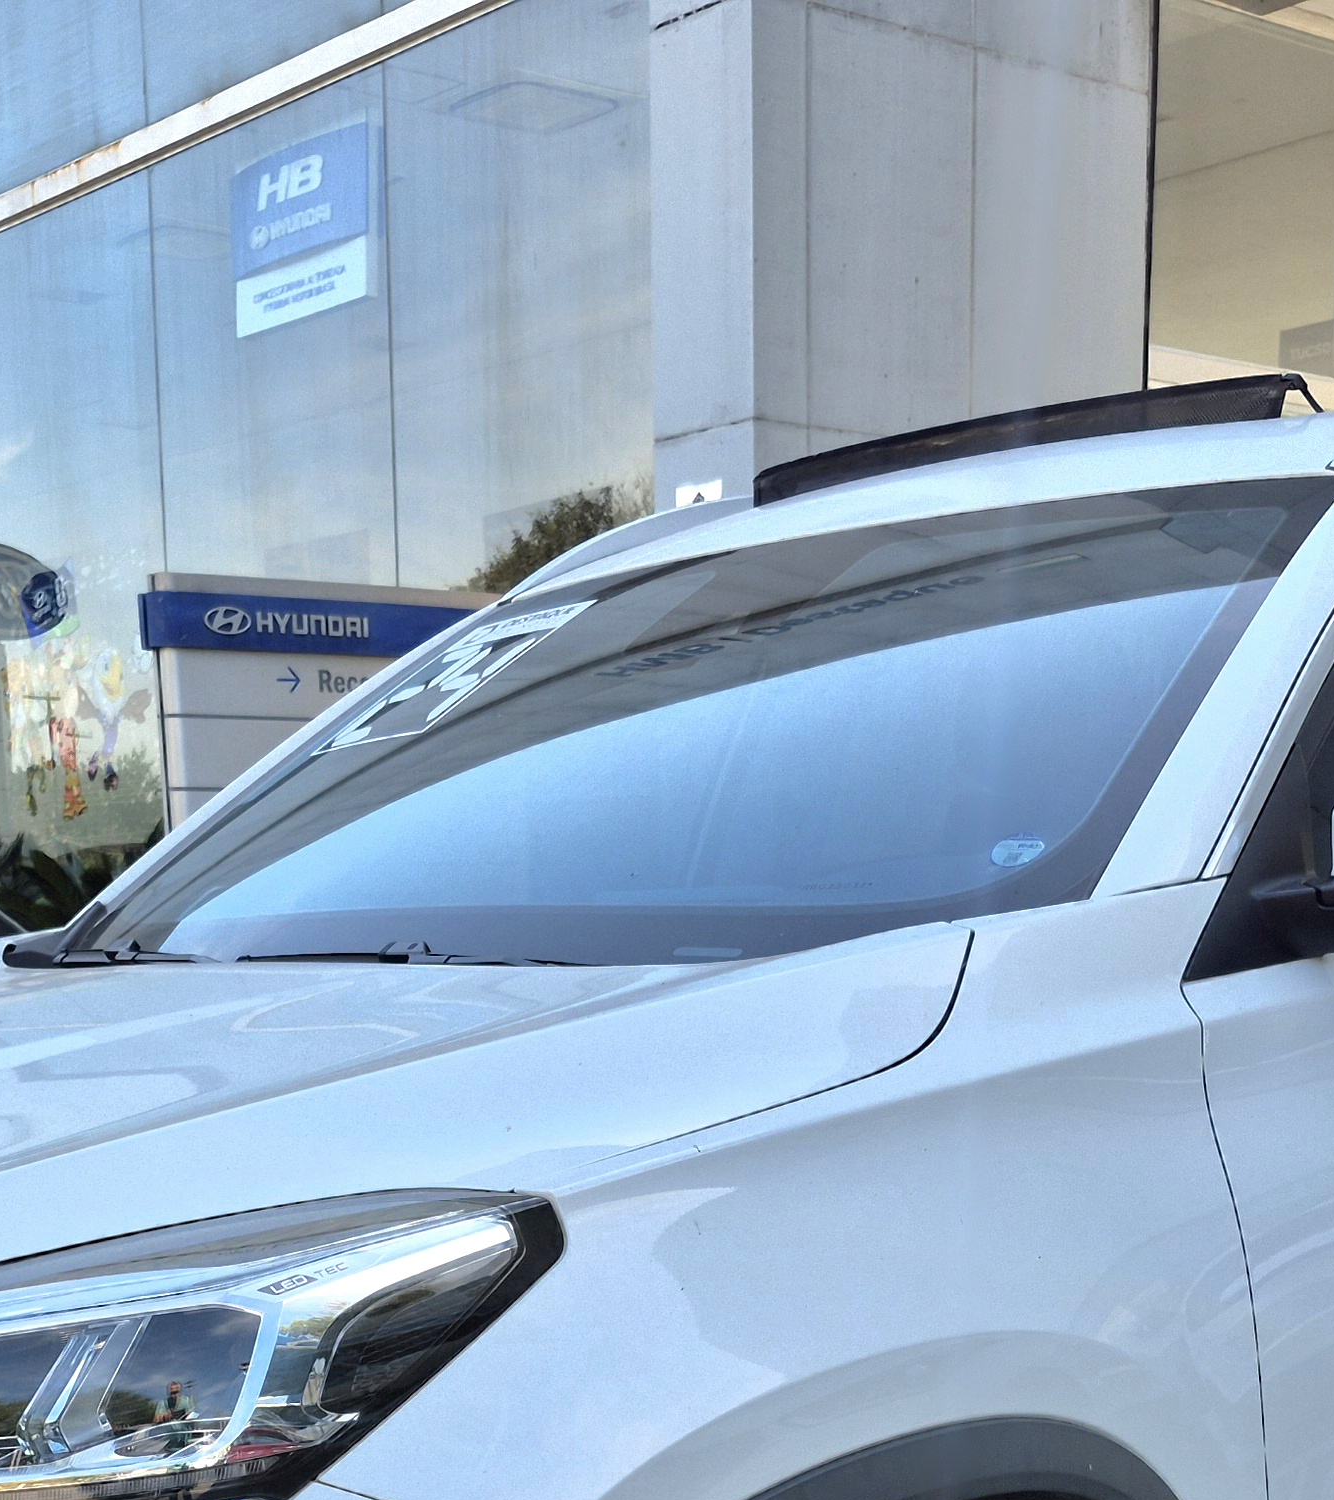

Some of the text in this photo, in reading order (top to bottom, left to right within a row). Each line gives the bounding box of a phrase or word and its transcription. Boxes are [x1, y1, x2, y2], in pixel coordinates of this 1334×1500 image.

[257, 154, 323, 212] HB
[256, 612, 370, 638] HYUNDAI
[269, 1262, 348, 1294] LED TEC
